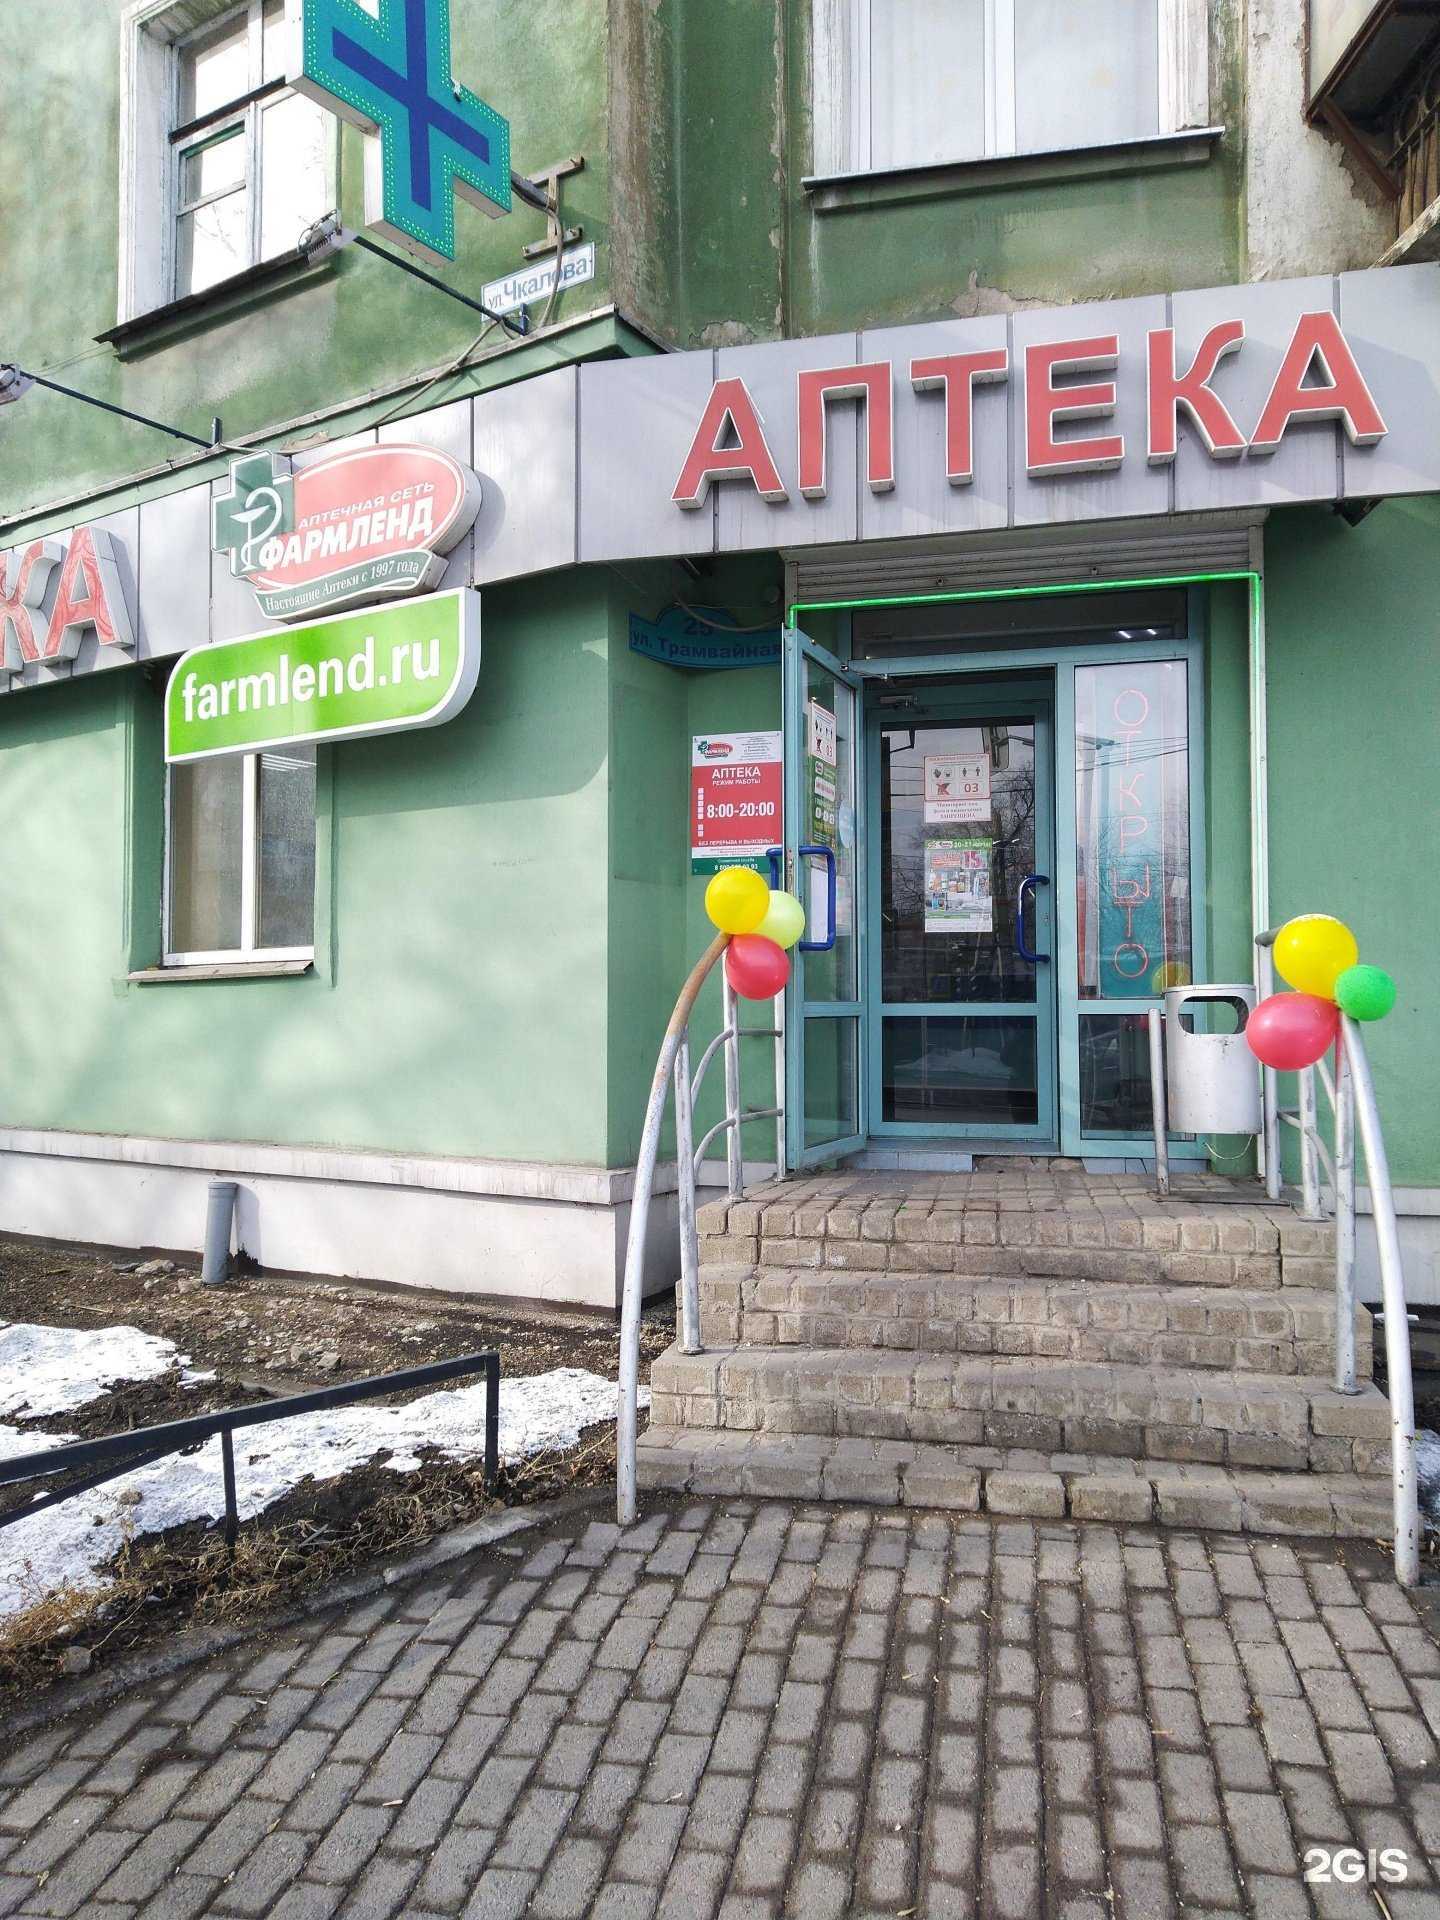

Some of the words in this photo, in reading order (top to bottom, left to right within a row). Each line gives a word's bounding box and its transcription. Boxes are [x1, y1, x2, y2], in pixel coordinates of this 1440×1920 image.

[488, 294, 504, 309] ул.
[504, 257, 587, 301] Чкалова
[671, 310, 1388, 508] АПТЕКА
[299, 495, 385, 529] АПТЕЧНАЯ
[390, 482, 435, 502] СЕТЬ
[258, 496, 435, 571] ФАРМЛЕНД
[265, 585, 321, 611] Настоящие
[322, 578, 360, 602] Аптеки
[361, 572, 367, 583] с
[370, 560, 396, 581] 1997
[396, 560, 420, 576] года
[632, 631, 653, 649] ул.
[182, 636, 440, 723] farmlend.ru
[712, 766, 761, 779] АПТЕКА
[964, 783, 979, 793] 03
[706, 801, 775, 818] 8:00-20:00
[1111, 689, 1151, 978] ОТКРЫТО
